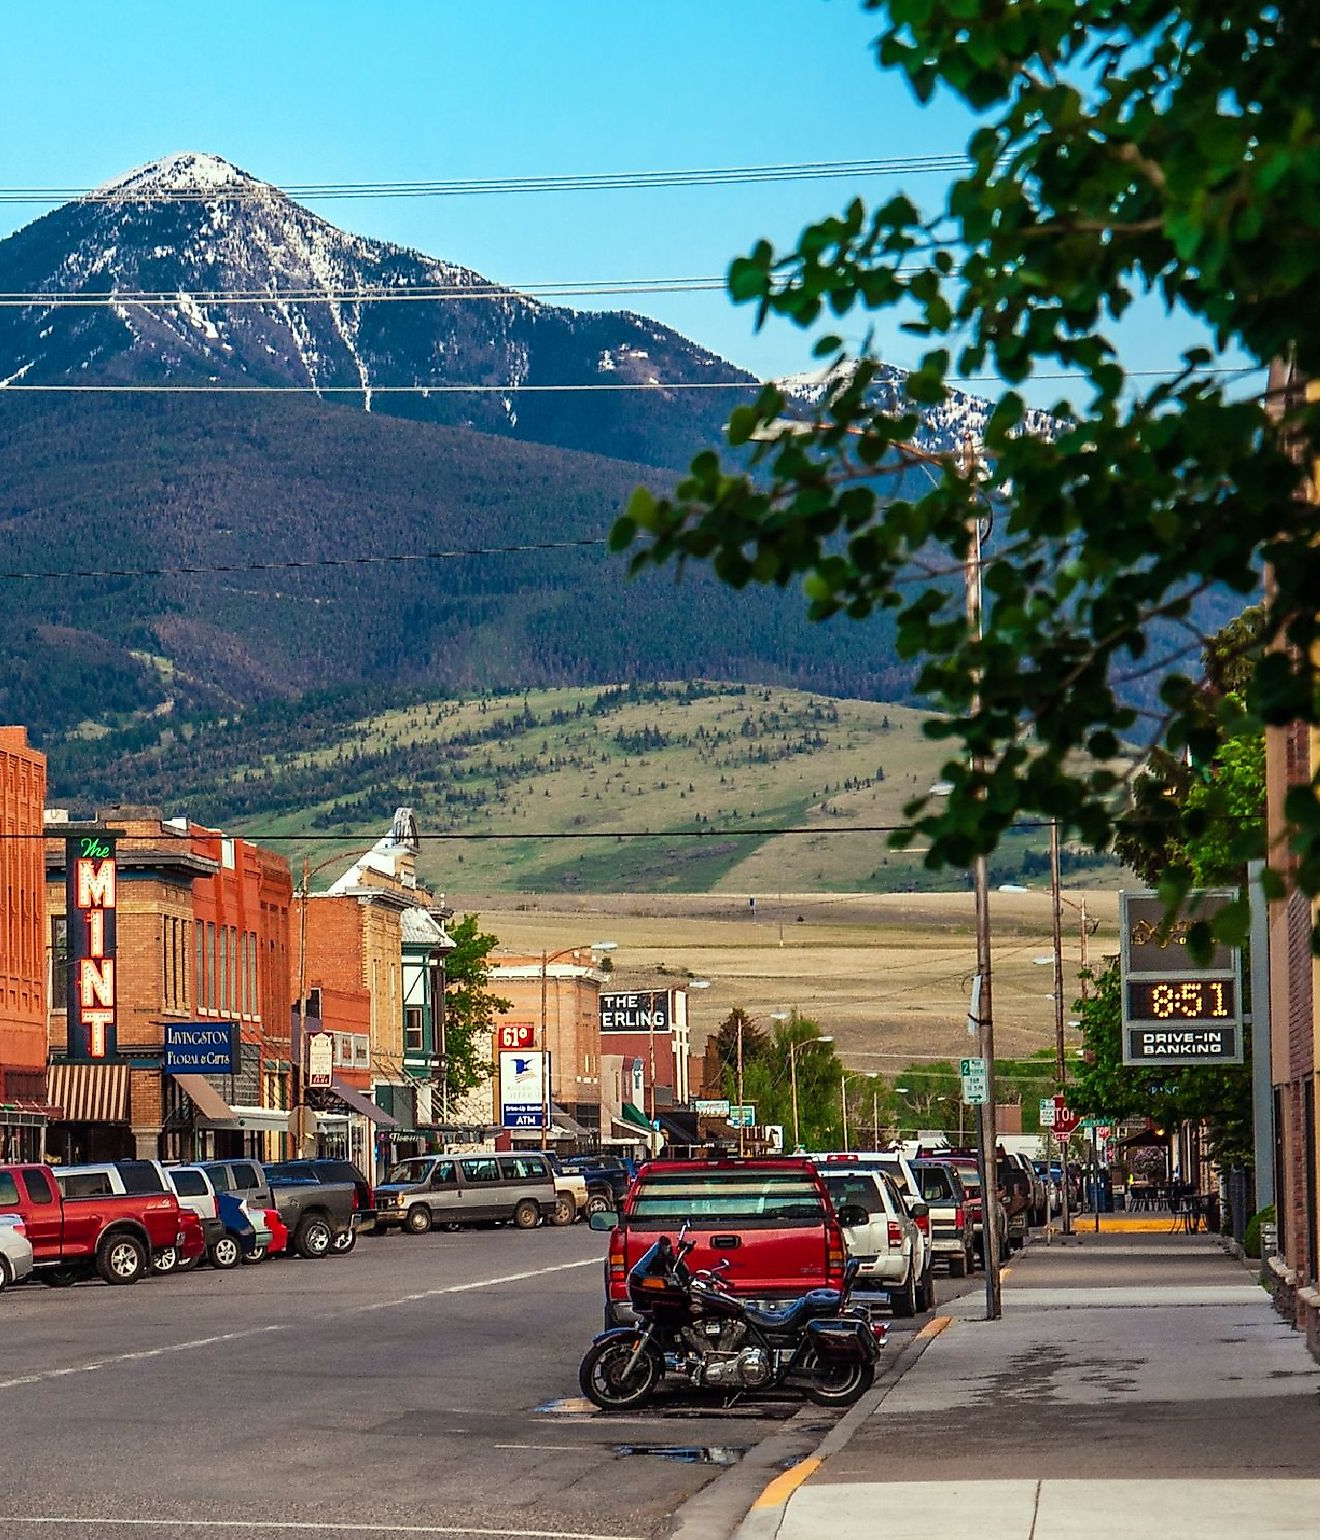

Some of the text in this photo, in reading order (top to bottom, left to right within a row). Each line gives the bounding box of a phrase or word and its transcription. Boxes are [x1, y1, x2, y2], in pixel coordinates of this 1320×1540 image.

[80, 837, 111, 858] The
[77, 859, 117, 1059] MINT
[604, 995, 638, 1009] THE
[1152, 982, 1228, 1018] 8:51
[1143, 1032, 1222, 1044] DRIVE-IN
[1143, 1044, 1222, 1055] BANKING
[515, 1115, 537, 1126] ATM
